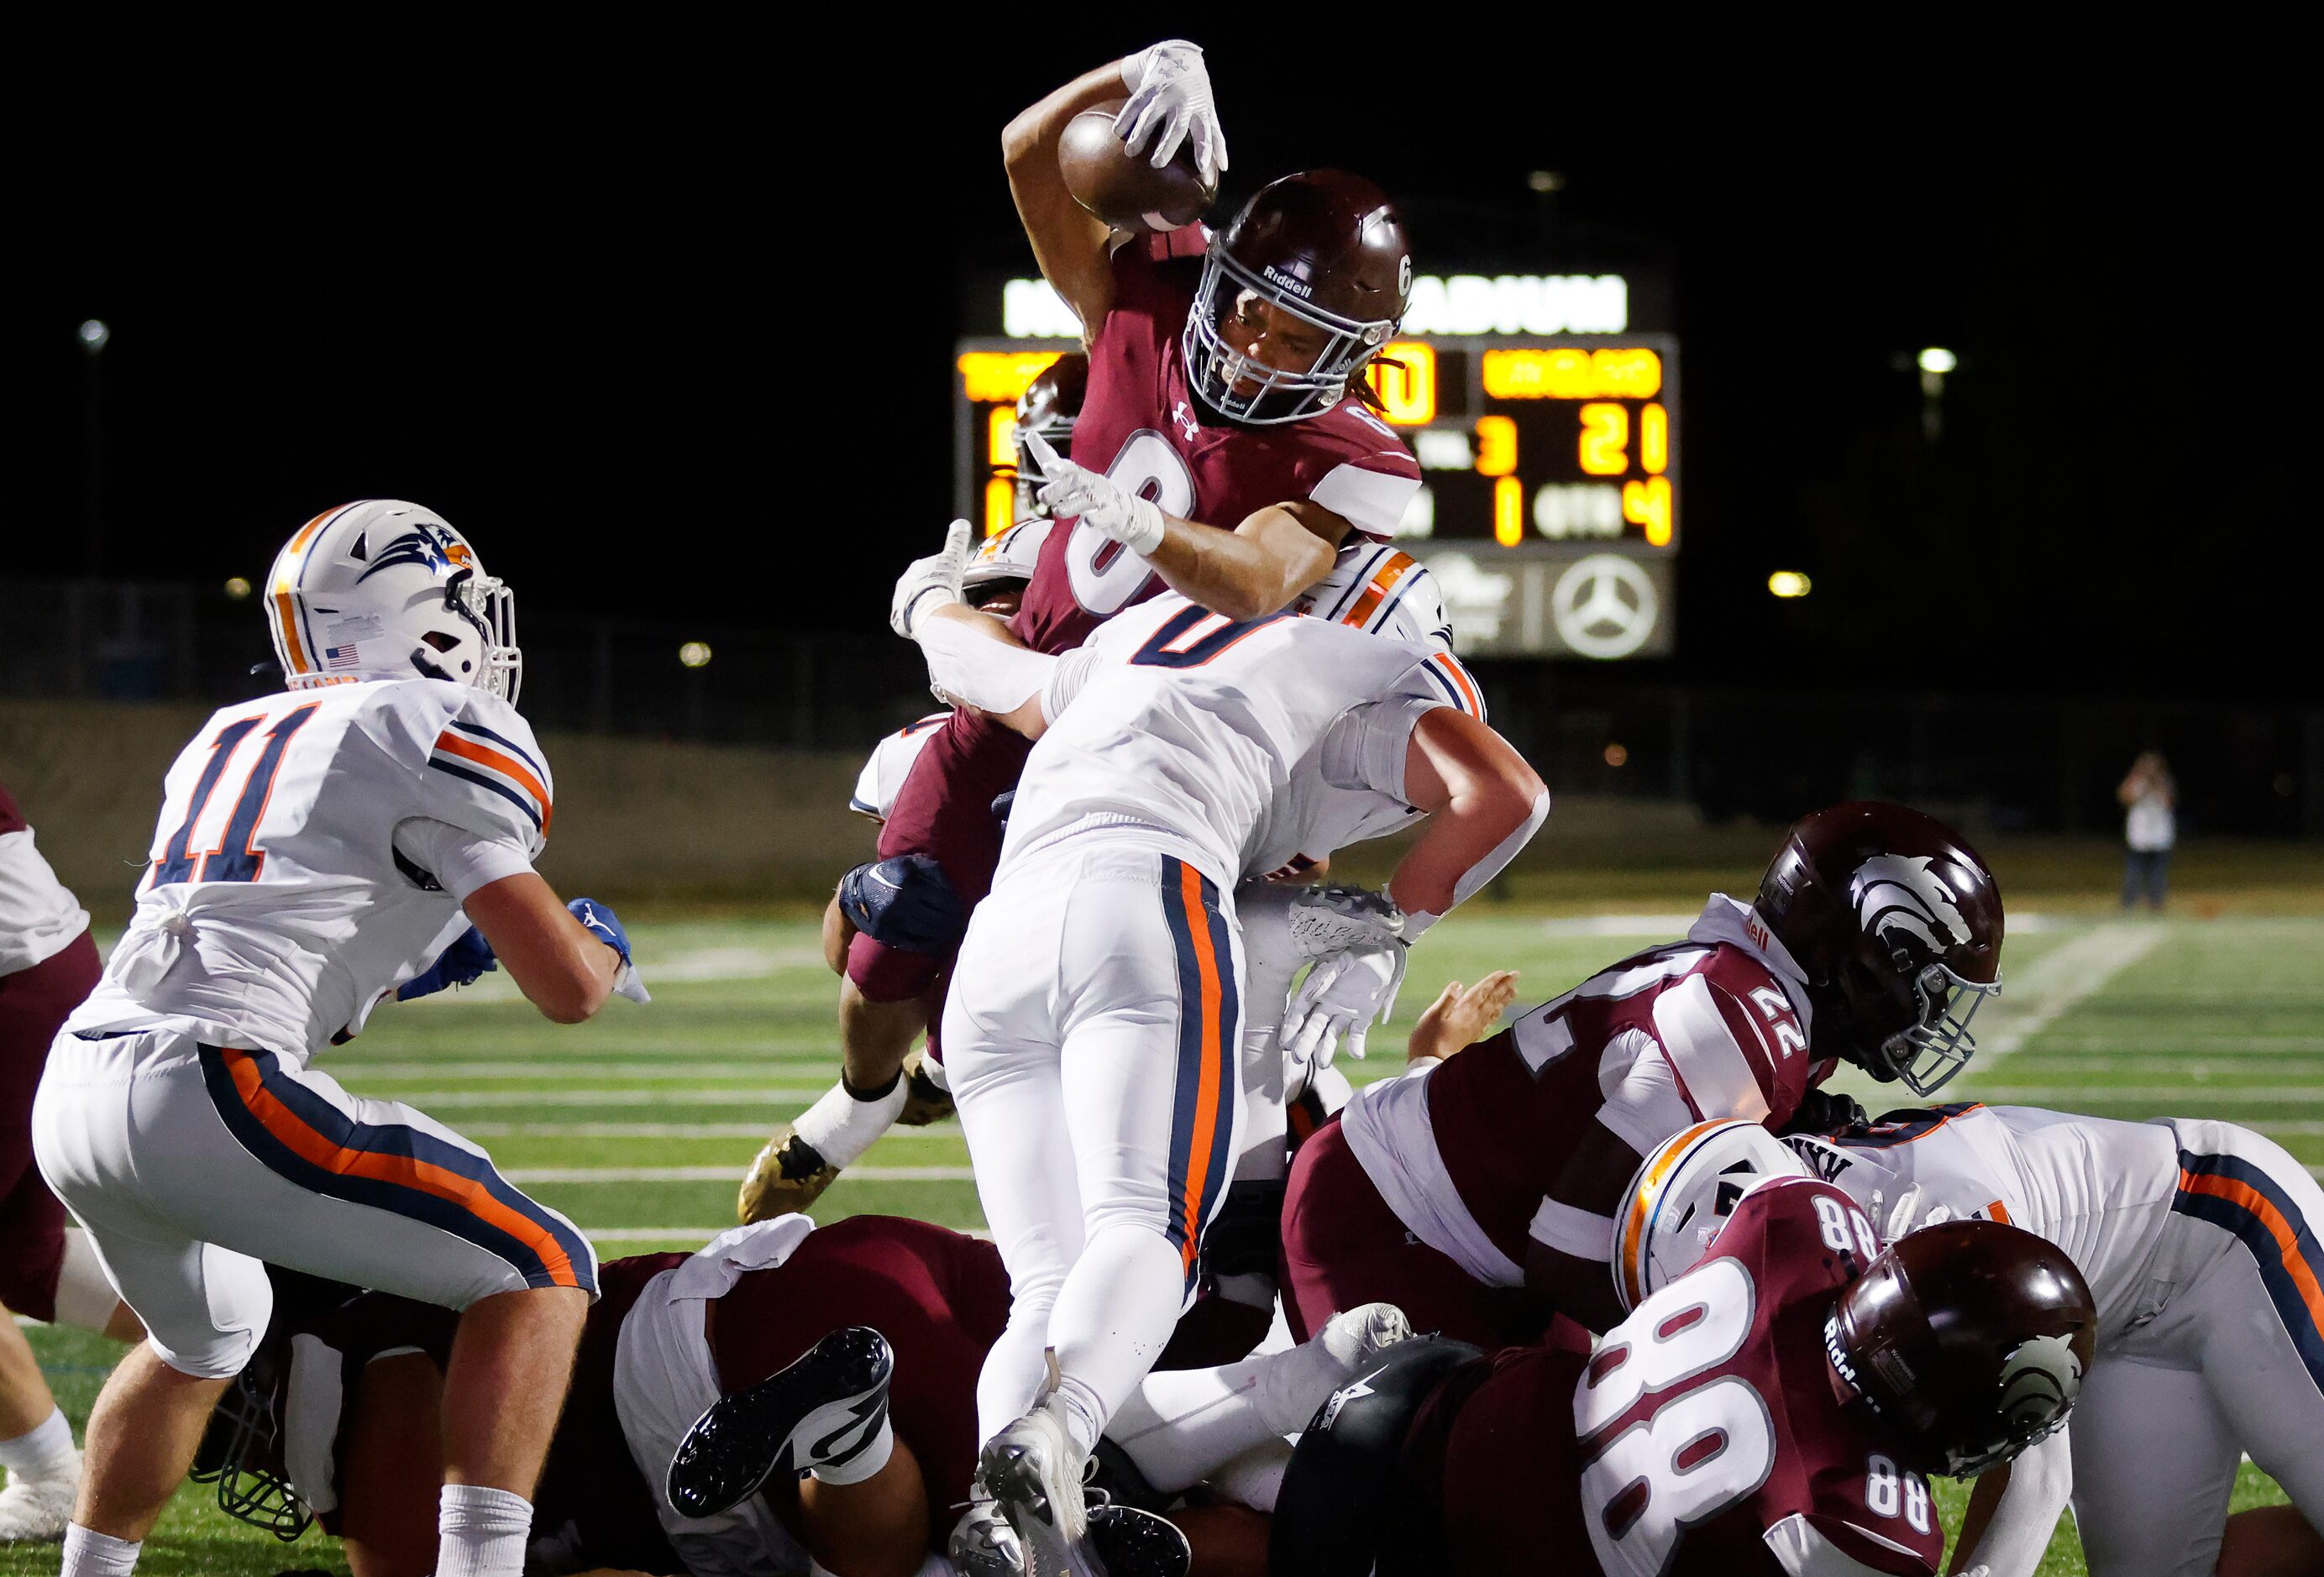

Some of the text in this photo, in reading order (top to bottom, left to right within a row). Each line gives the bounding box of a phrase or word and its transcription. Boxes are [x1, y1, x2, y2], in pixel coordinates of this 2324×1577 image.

[1263, 265, 1312, 298] Riddell
[1398, 254, 1412, 296] 6
[1220, 395, 1246, 410] Rddell
[1364, 340, 1437, 427] 0
[1476, 416, 1518, 476] 3
[1579, 402, 1668, 474] 21
[1494, 474, 1524, 547] 1
[1622, 474, 1672, 547] 4
[149, 700, 323, 892] 11
[1747, 978, 1807, 1060] 22
[1811, 1193, 1878, 1264] 88
[1572, 1256, 1776, 1577] 88
[1865, 1453, 1931, 1536] 88
